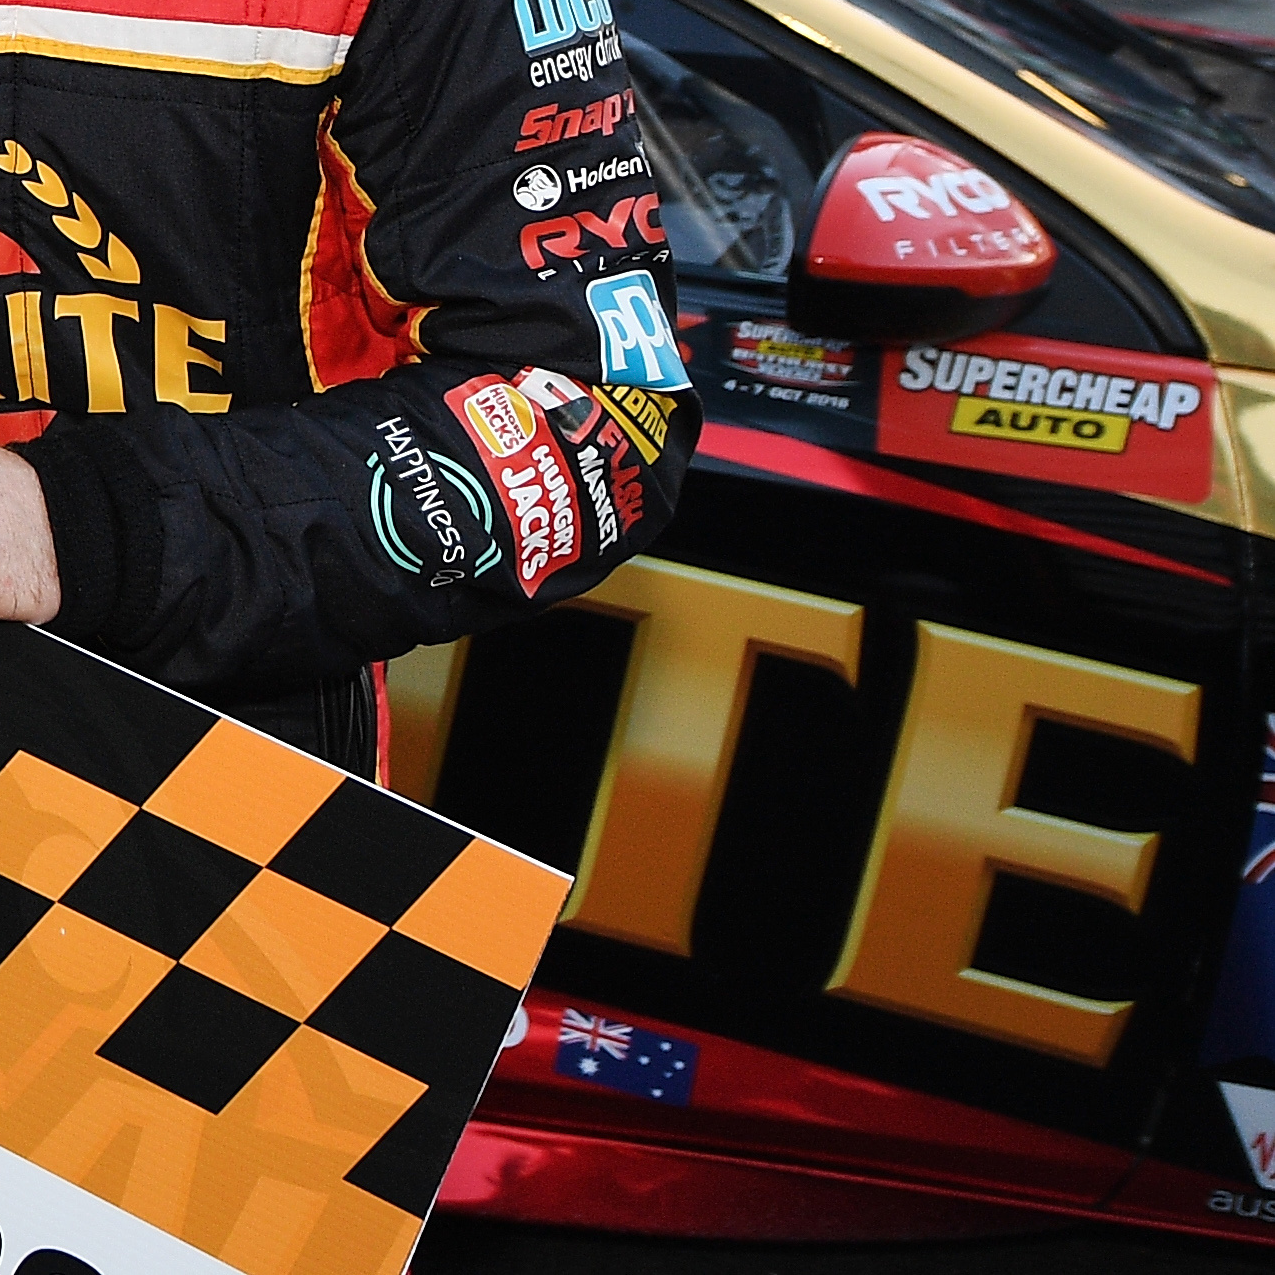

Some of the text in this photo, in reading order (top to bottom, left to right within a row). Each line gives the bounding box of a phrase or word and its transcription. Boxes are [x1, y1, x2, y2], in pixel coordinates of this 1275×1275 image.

[530, 44, 594, 87] energy
[567, 156, 643, 193] Holden
[858, 168, 1012, 222] RYCO
[489, 387, 527, 441] HUNGRY
[899, 348, 1200, 431] SUPERCHEAP
[476, 397, 521, 451] JACK'S
[975, 408, 1105, 440] AUTO
[501, 467, 551, 581] JACK'S
[532, 445, 575, 558] HUNGRY
[577, 445, 618, 551] MARKET
